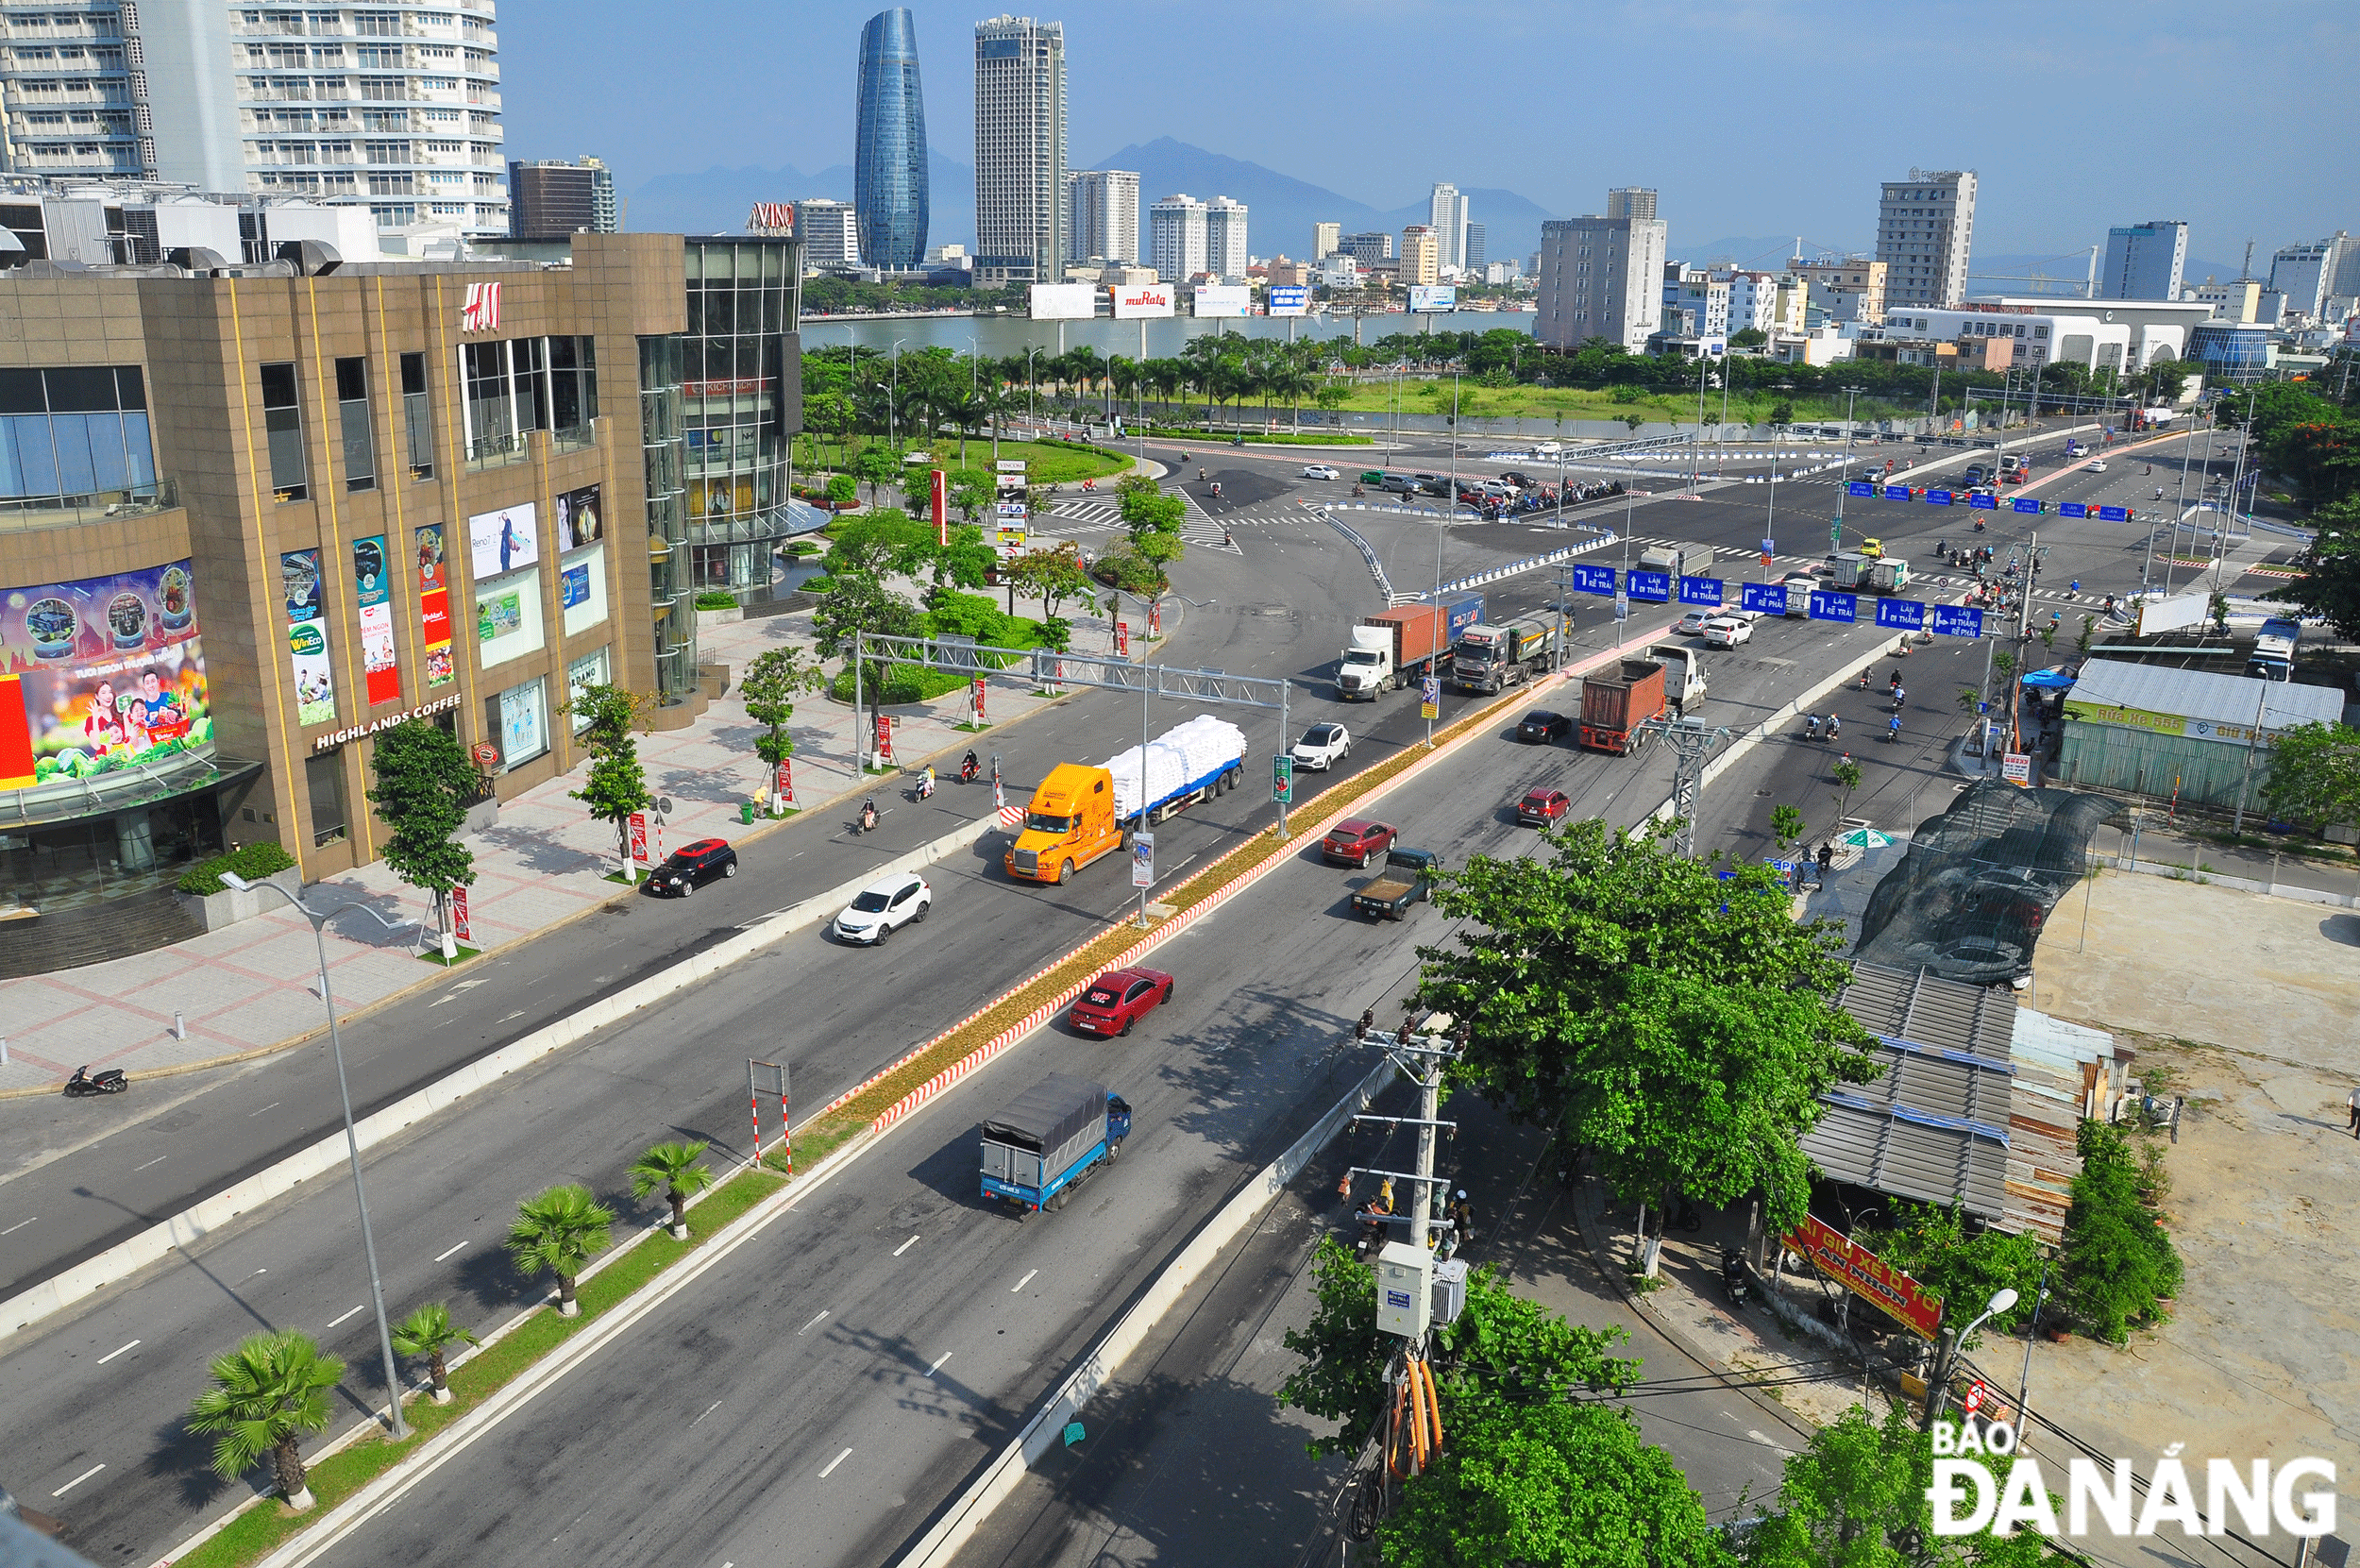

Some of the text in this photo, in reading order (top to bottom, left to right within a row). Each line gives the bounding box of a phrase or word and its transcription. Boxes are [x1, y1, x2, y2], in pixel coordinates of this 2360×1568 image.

[1125, 291, 1166, 307] muRata
[316, 693, 462, 750] HIGHLANDS COFFEE
[2152, 717, 2181, 730] 555
[1817, 1247, 1847, 1270] AN
[1858, 1253, 1883, 1279] XE
